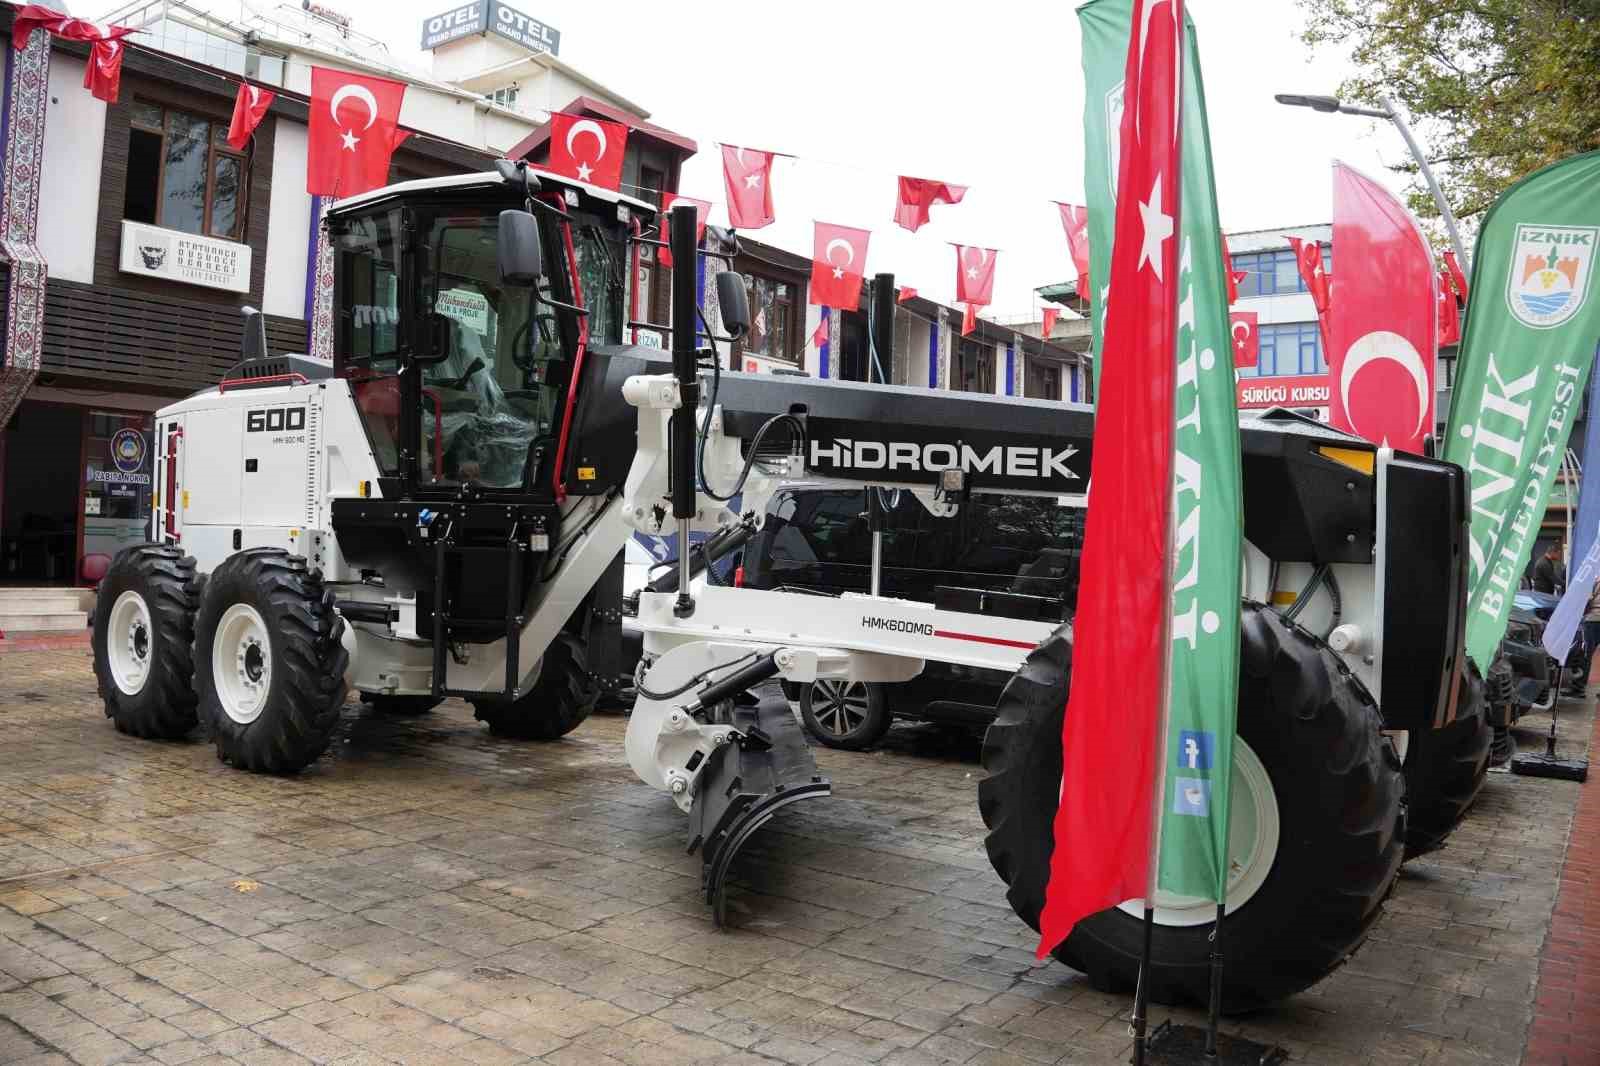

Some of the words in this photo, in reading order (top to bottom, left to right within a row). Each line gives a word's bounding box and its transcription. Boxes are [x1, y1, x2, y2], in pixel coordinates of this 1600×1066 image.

[428, 4, 480, 33] OTEL
[497, 6, 553, 44] OTEL
[1241, 385, 1287, 403] SÜRÜCÜ
[1291, 386, 1330, 401] KURSU
[247, 406, 306, 433] 600
[1479, 361, 1582, 624] BELEDİYESİ
[862, 615, 934, 636] HMK600MG
